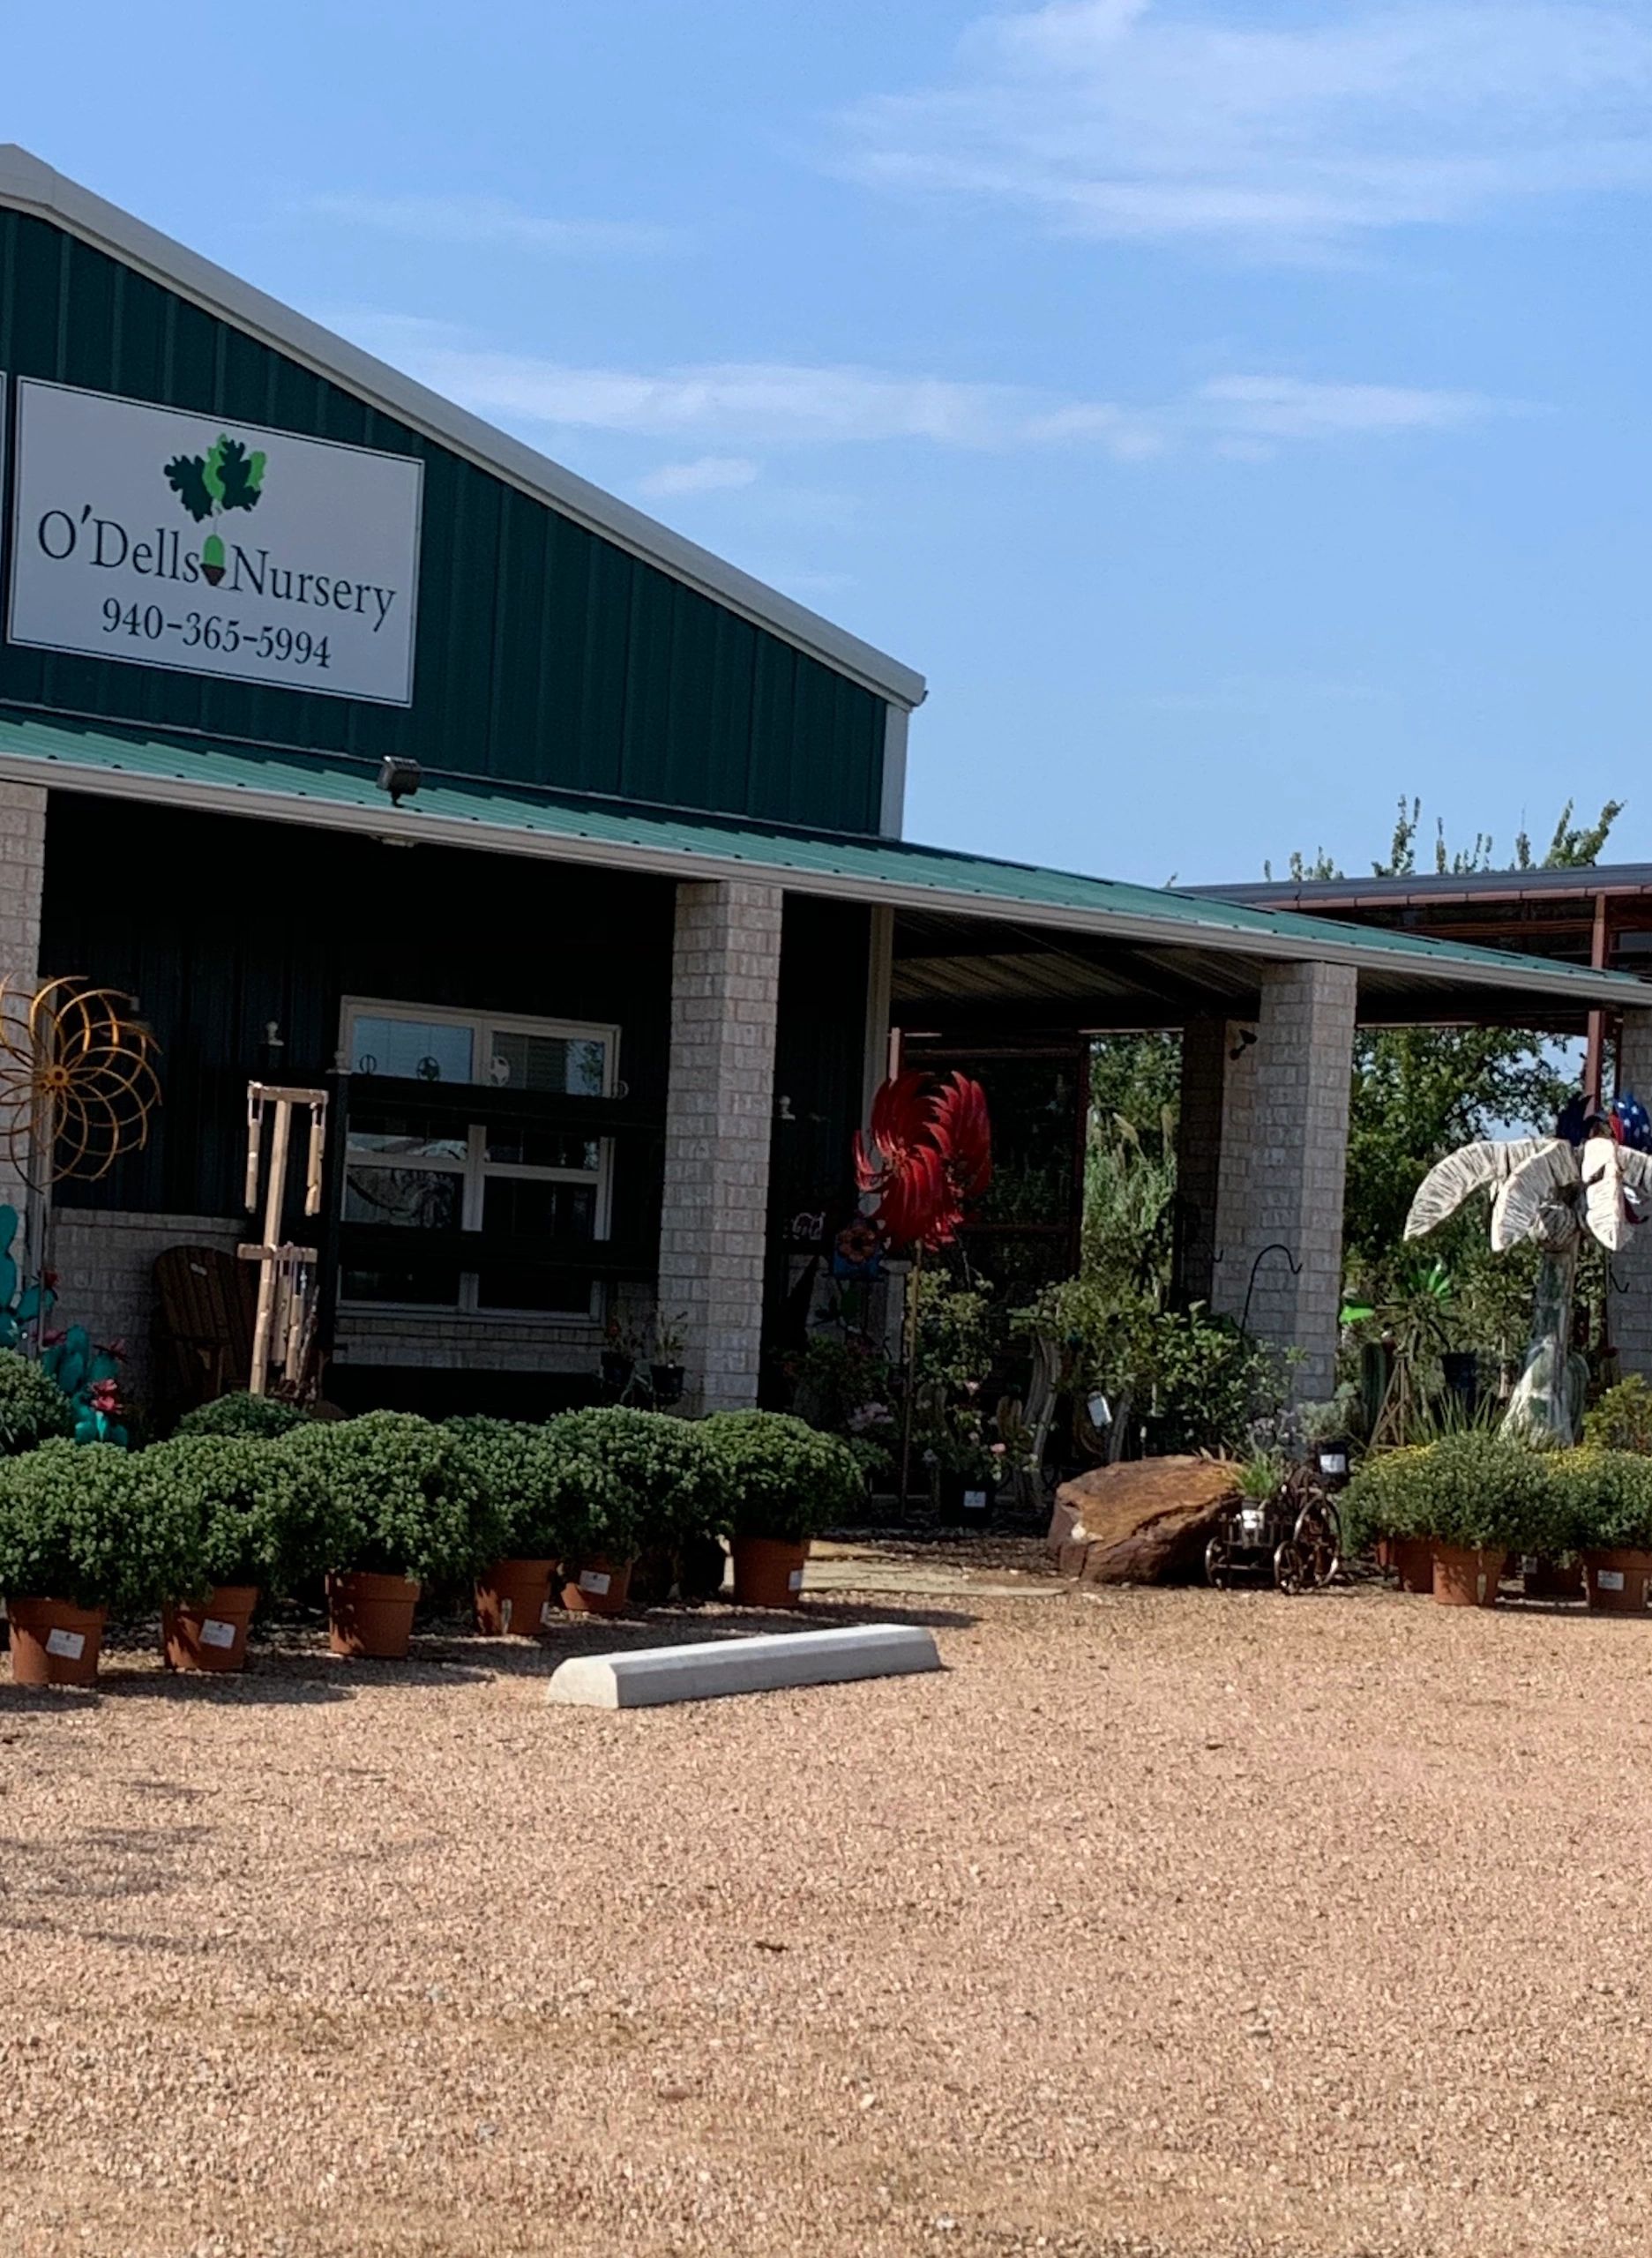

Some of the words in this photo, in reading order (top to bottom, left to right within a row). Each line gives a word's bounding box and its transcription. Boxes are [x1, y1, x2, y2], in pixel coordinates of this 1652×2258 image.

[38, 504, 200, 584] O'Dells
[230, 545, 397, 632] Nursery
[102, 597, 332, 669] 940-365-5994
